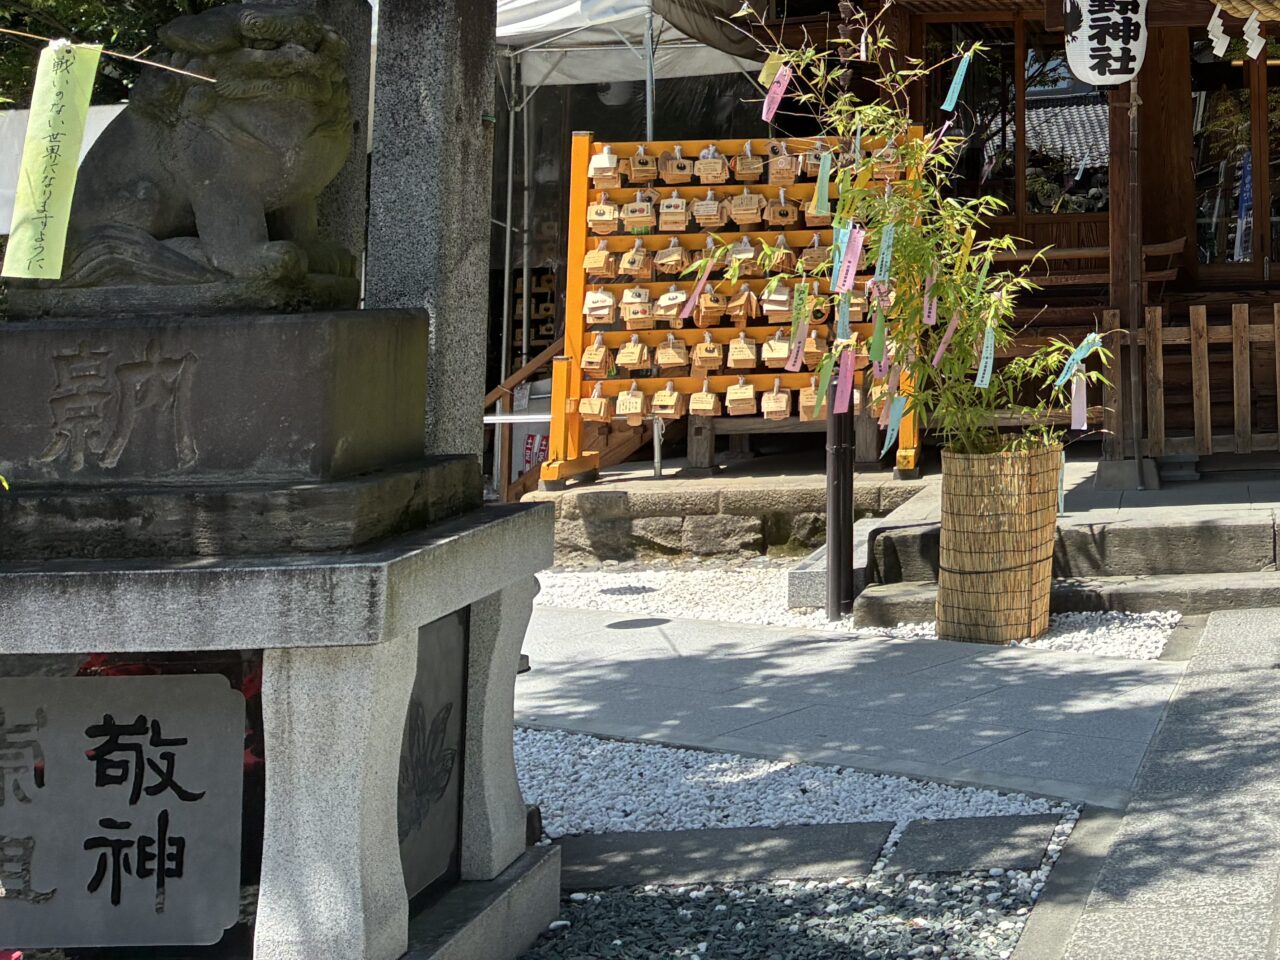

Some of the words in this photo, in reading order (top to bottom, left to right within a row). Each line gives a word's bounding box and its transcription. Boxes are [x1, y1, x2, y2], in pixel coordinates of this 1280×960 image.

[27, 54, 76, 271] 戦いのない世界になりますように
[84, 713, 207, 914] 敬神
